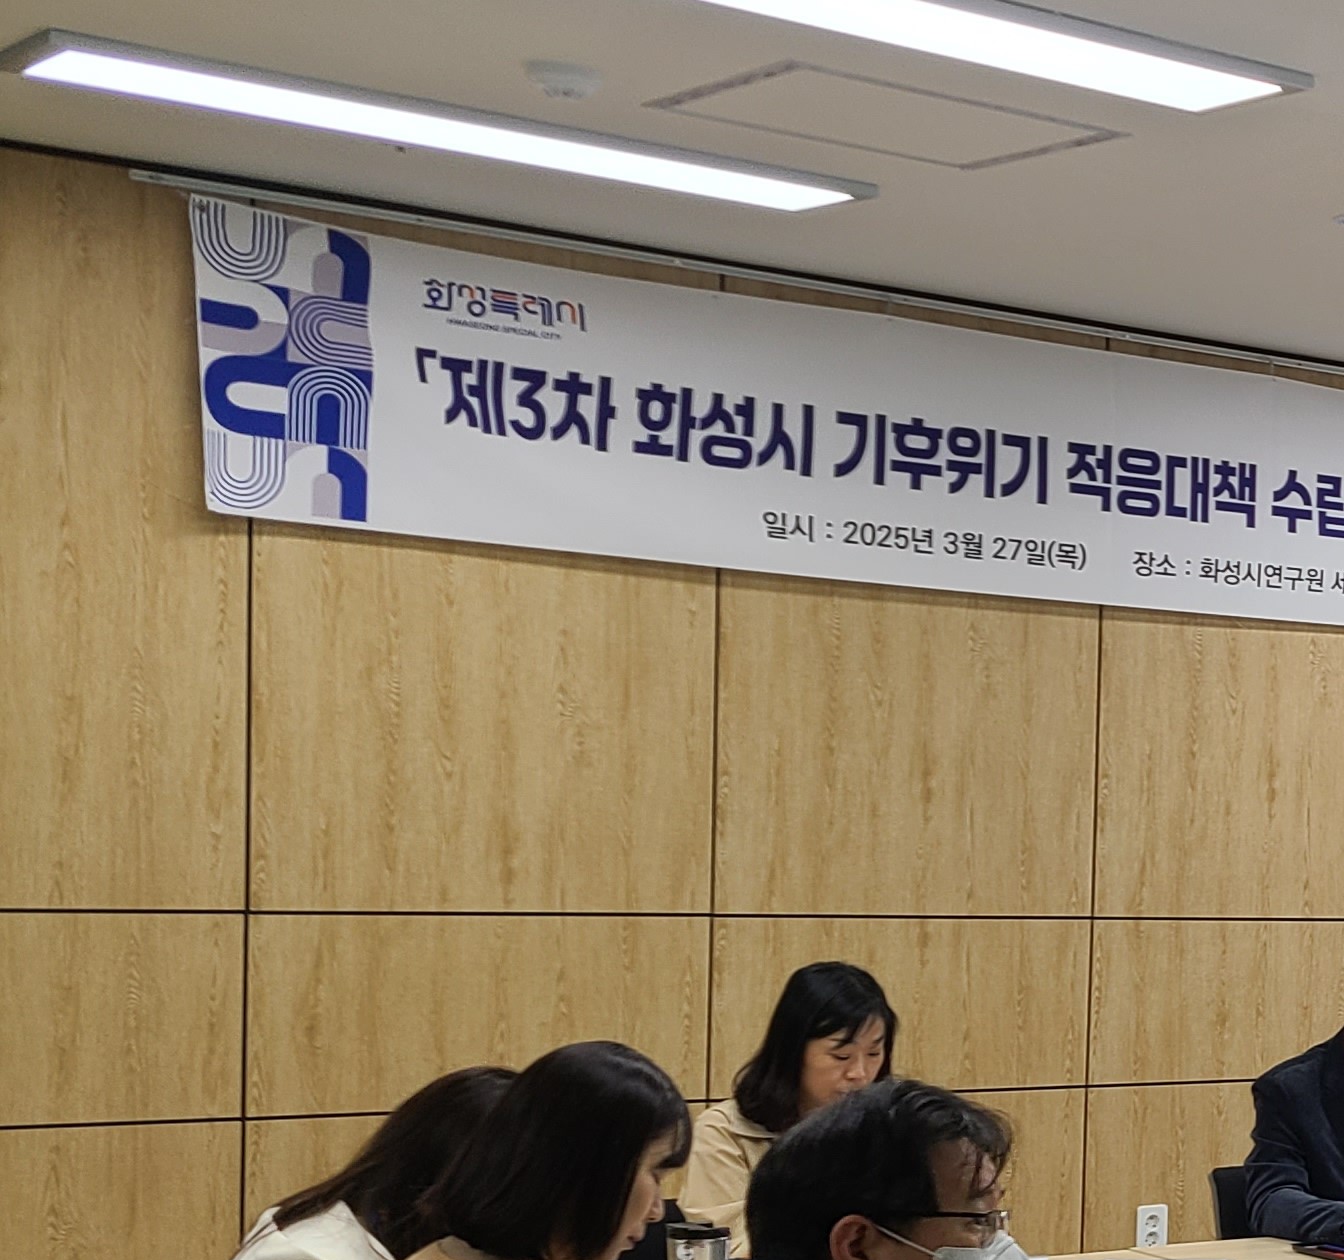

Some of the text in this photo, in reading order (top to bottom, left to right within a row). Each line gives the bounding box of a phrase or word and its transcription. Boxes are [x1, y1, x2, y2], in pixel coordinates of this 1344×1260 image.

[422, 278, 588, 332] 화성특례시
[415, 347, 617, 451] 「제3차
[633, 383, 815, 477] 화성시
[833, 410, 1049, 504] 기후위기
[1067, 440, 1257, 528] 적응대책
[763, 511, 815, 543] 일시
[842, 521, 935, 555] 2025년
[943, 531, 984, 560] 3월
[991, 536, 1087, 571] 27일(목)
[1133, 551, 1177, 577] 장소
[1199, 557, 1324, 592] 화성시연구원
